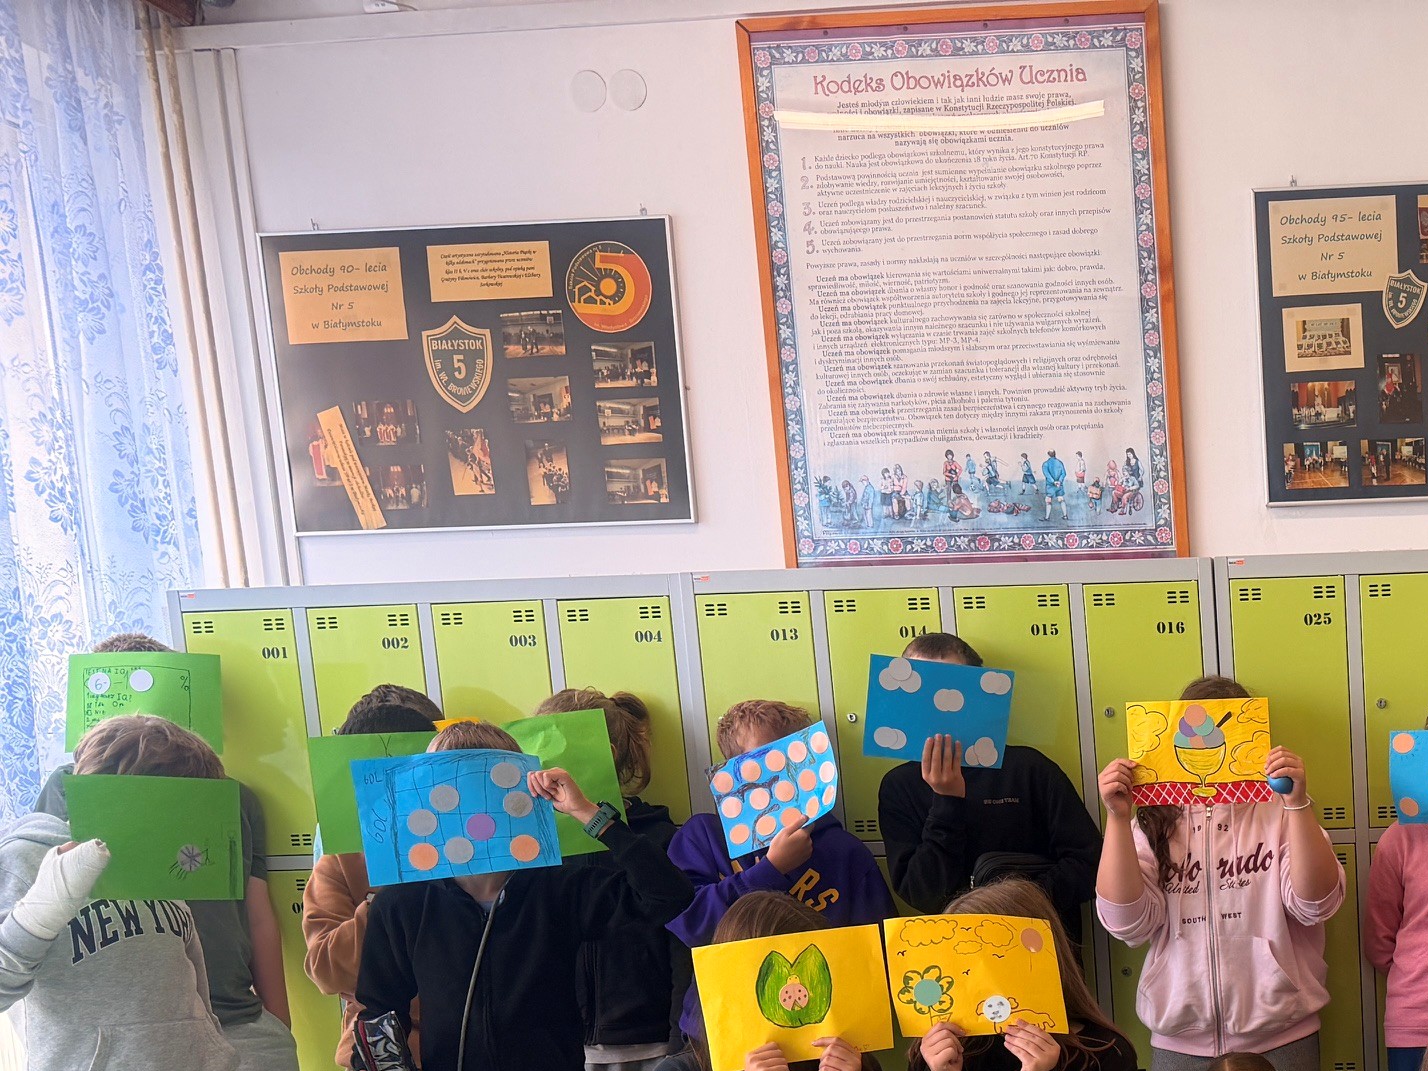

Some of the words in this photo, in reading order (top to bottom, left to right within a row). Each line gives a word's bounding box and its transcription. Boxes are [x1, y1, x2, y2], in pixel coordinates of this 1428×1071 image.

[813, 72, 886, 96] Kodeks
[890, 67, 1014, 92] Obowiązków
[1019, 64, 1087, 85] Ucznia
[837, 101, 859, 109] Jesteś
[861, 99, 889, 108] młodym
[891, 97, 934, 106] człowiekiem
[954, 95, 965, 105] jak
[966, 94, 981, 103] inni
[903, 107, 934, 115] zapisane
[944, 103, 984, 112] Konstytucji
[987, 101, 1045, 111] Rzeczypospolitej
[895, 137, 926, 147] nazywają
[929, 136, 938, 145] się
[940, 135, 986, 145] obowiązkami
[1280, 212, 1326, 226] Obchody
[1358, 211, 1382, 222] lecia
[1281, 233, 1313, 245] Szkoły
[1317, 230, 1382, 243] Podstawowej
[1320, 252, 1333, 261] Nr
[1337, 251, 1345, 260] 5
[291, 264, 335, 276] Obchody
[365, 262, 387, 272] lecia
[1298, 273, 1307, 281] w
[1311, 268, 1372, 282] Białymstoku
[850, 273, 884, 282] obowiązek
[293, 284, 323, 295] Szkoły
[327, 281, 389, 293] Podstawowej
[331, 302, 343, 310] Nr
[347, 302, 355, 310] 5
[1397, 293, 1408, 309] 5
[323, 318, 382, 330] Białymstoku
[431, 339, 483, 350] BIAŁYSTOK
[453, 354, 467, 379] 5
[1303, 612, 1333, 627] 025
[899, 625, 928, 639] 014
[1030, 622, 1060, 637] 015
[1156, 620, 1186, 635] 016
[509, 634, 537, 647] 003
[634, 629, 663, 643] 004
[769, 628, 799, 642] 013
[381, 637, 409, 650] 002
[262, 646, 289, 660] 001
[1181, 916, 1207, 925] SOUTH
[1221, 912, 1242, 920] WEST
[67, 900, 144, 966] NEW
